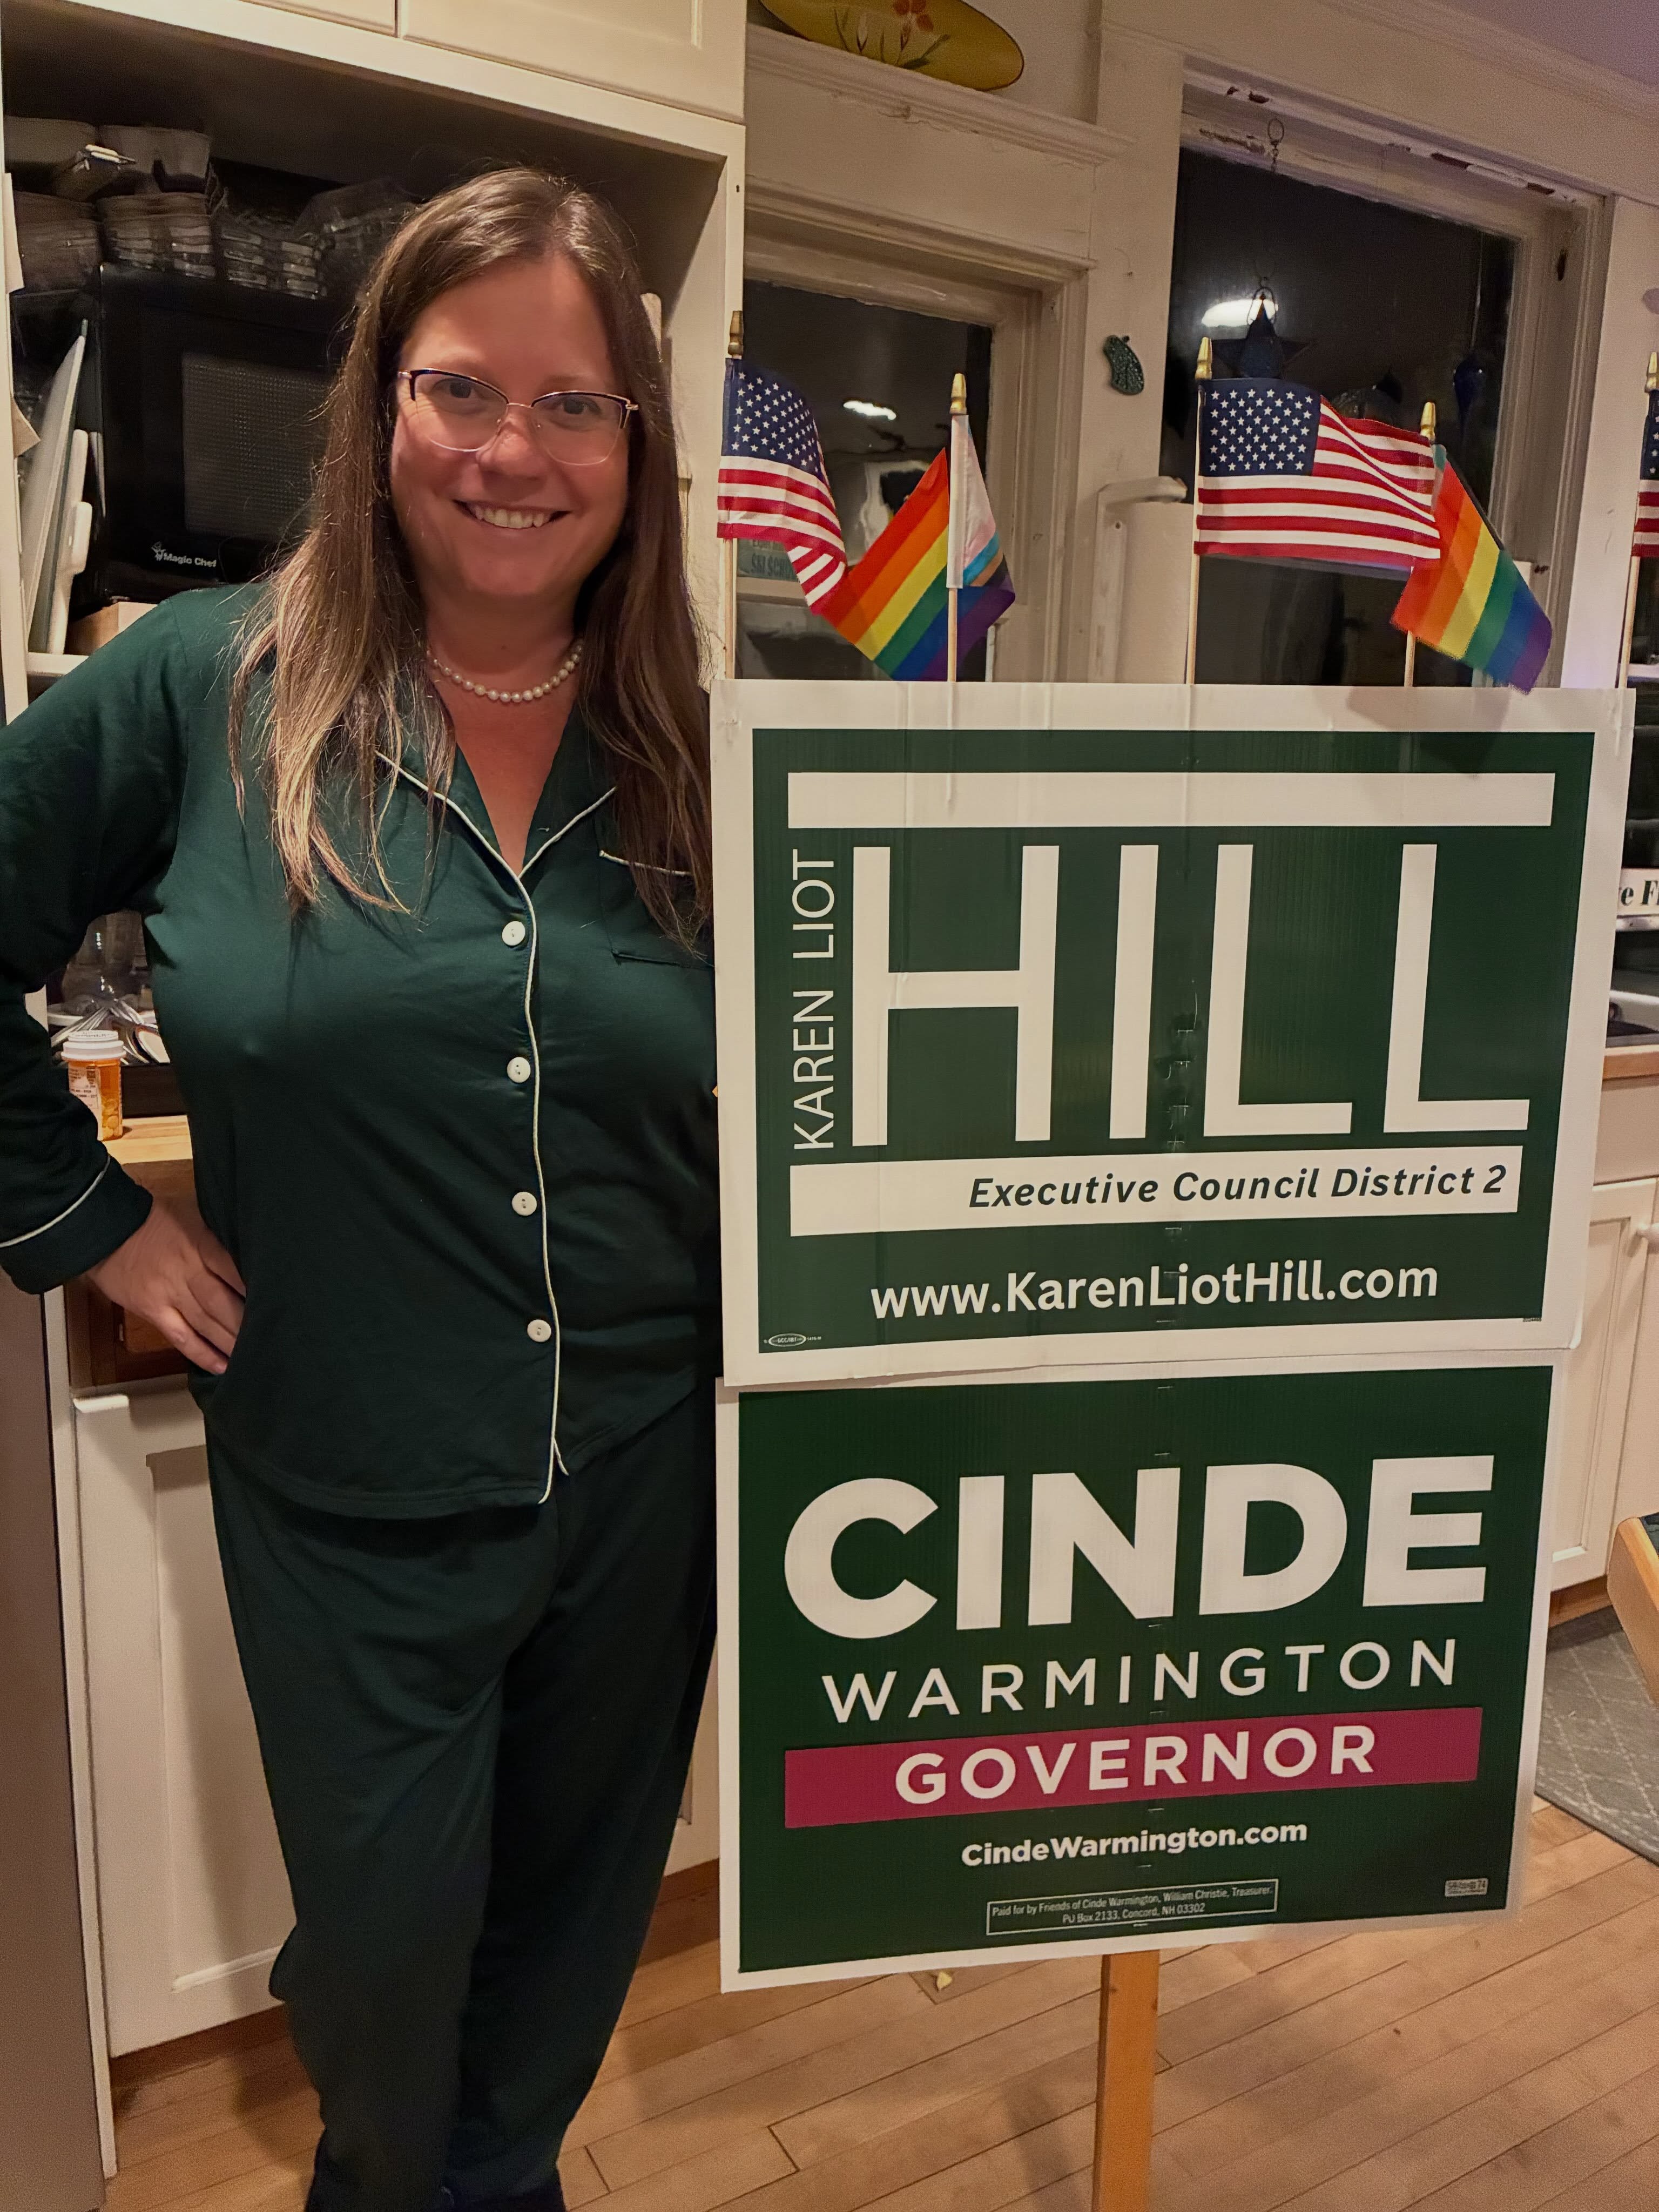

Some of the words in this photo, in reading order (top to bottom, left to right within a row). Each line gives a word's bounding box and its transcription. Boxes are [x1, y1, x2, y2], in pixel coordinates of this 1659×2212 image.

[163, 552, 192, 565] Magic
[194, 557, 217, 568] Chef
[791, 848, 834, 959] LIOT
[1618, 886, 1634, 906] e
[853, 845, 1530, 1147] HILL
[792, 990, 834, 1150] KAREN
[969, 1173, 1158, 1208] Executive
[1174, 1168, 1320, 1201] Council
[1331, 1166, 1475, 1197] District
[1482, 1166, 1506, 1193] 2
[871, 1259, 1438, 1319] www.KarenLiotHill.com
[784, 1455, 1494, 1639] CINDE
[821, 1638, 1455, 1723] WARMINGTON
[895, 1725, 1375, 1804] GOVERNOR
[962, 1824, 1307, 1866] CindeWarmington.com
[992, 1906, 1011, 1917] Paid
[1013, 1905, 1025, 1915] for
[1027, 1904, 1038, 1916] by
[1038, 1901, 1071, 1913] Friends
[1071, 1899, 1082, 1910] of
[1082, 1898, 1107, 1909] Cinde
[1163, 1891, 1193, 1901] William
[1077, 1913, 1094, 1923] Box
[1162, 1906, 1176, 1916] NH
[1176, 1903, 1206, 1914] 03302
